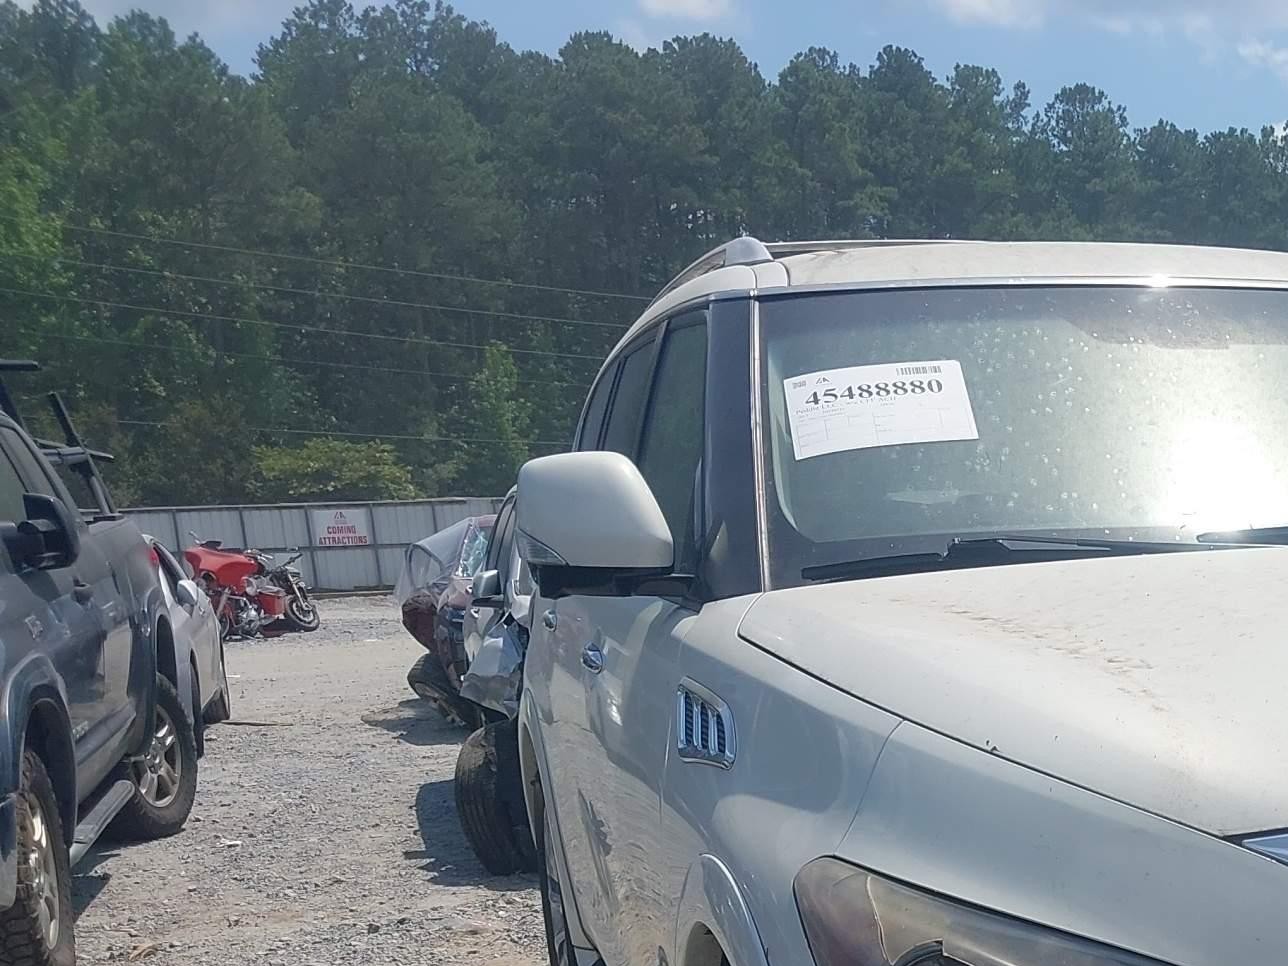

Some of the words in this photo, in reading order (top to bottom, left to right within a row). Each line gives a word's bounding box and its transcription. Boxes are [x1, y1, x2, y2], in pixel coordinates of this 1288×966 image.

[805, 379, 942, 406] 45488880
[327, 525, 356, 535] COMING
[319, 536, 367, 545] ATTRACTIONS
